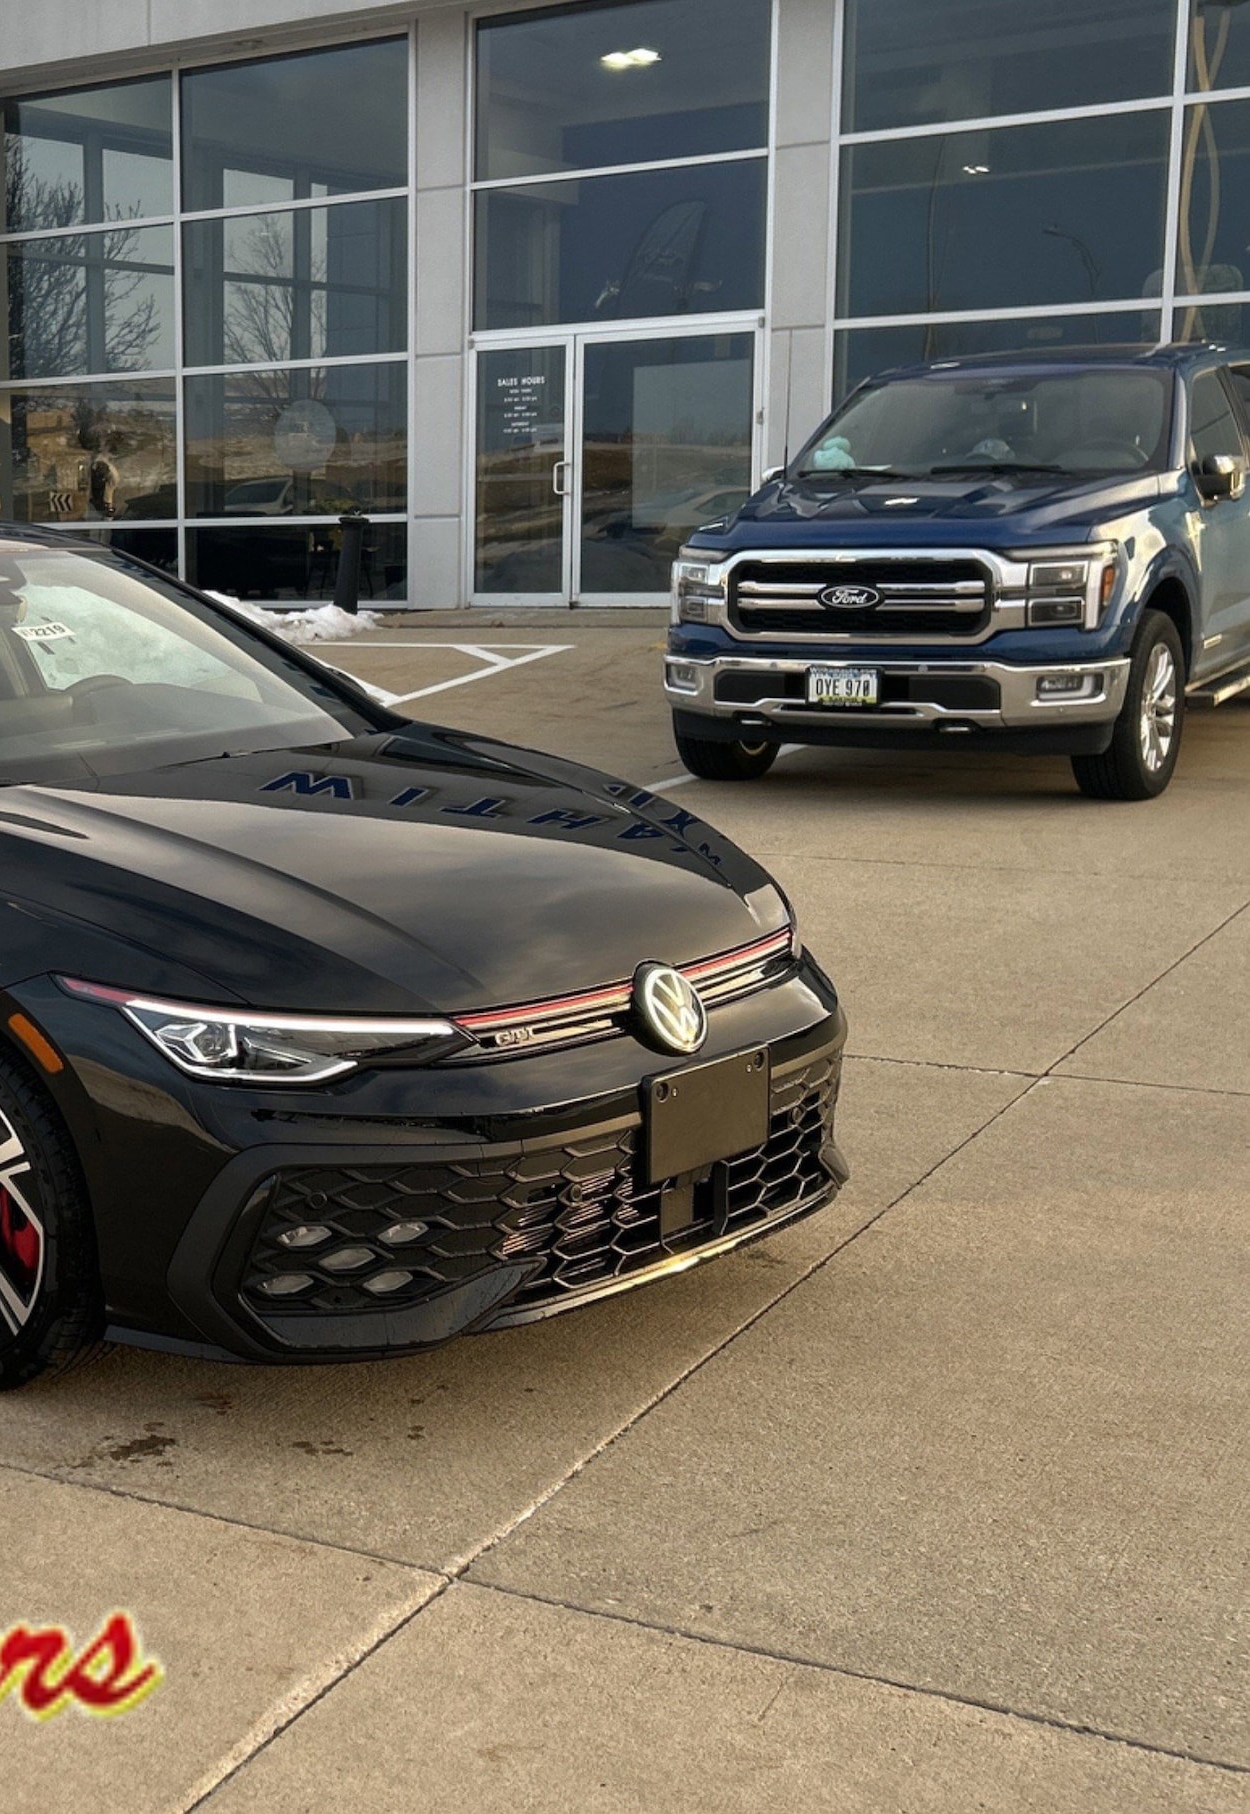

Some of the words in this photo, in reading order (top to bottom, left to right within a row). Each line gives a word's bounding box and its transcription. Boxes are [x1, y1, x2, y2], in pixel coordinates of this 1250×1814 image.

[497, 378, 518, 387] SALES
[521, 376, 545, 386] HOURS
[832, 589, 868, 604] Ford
